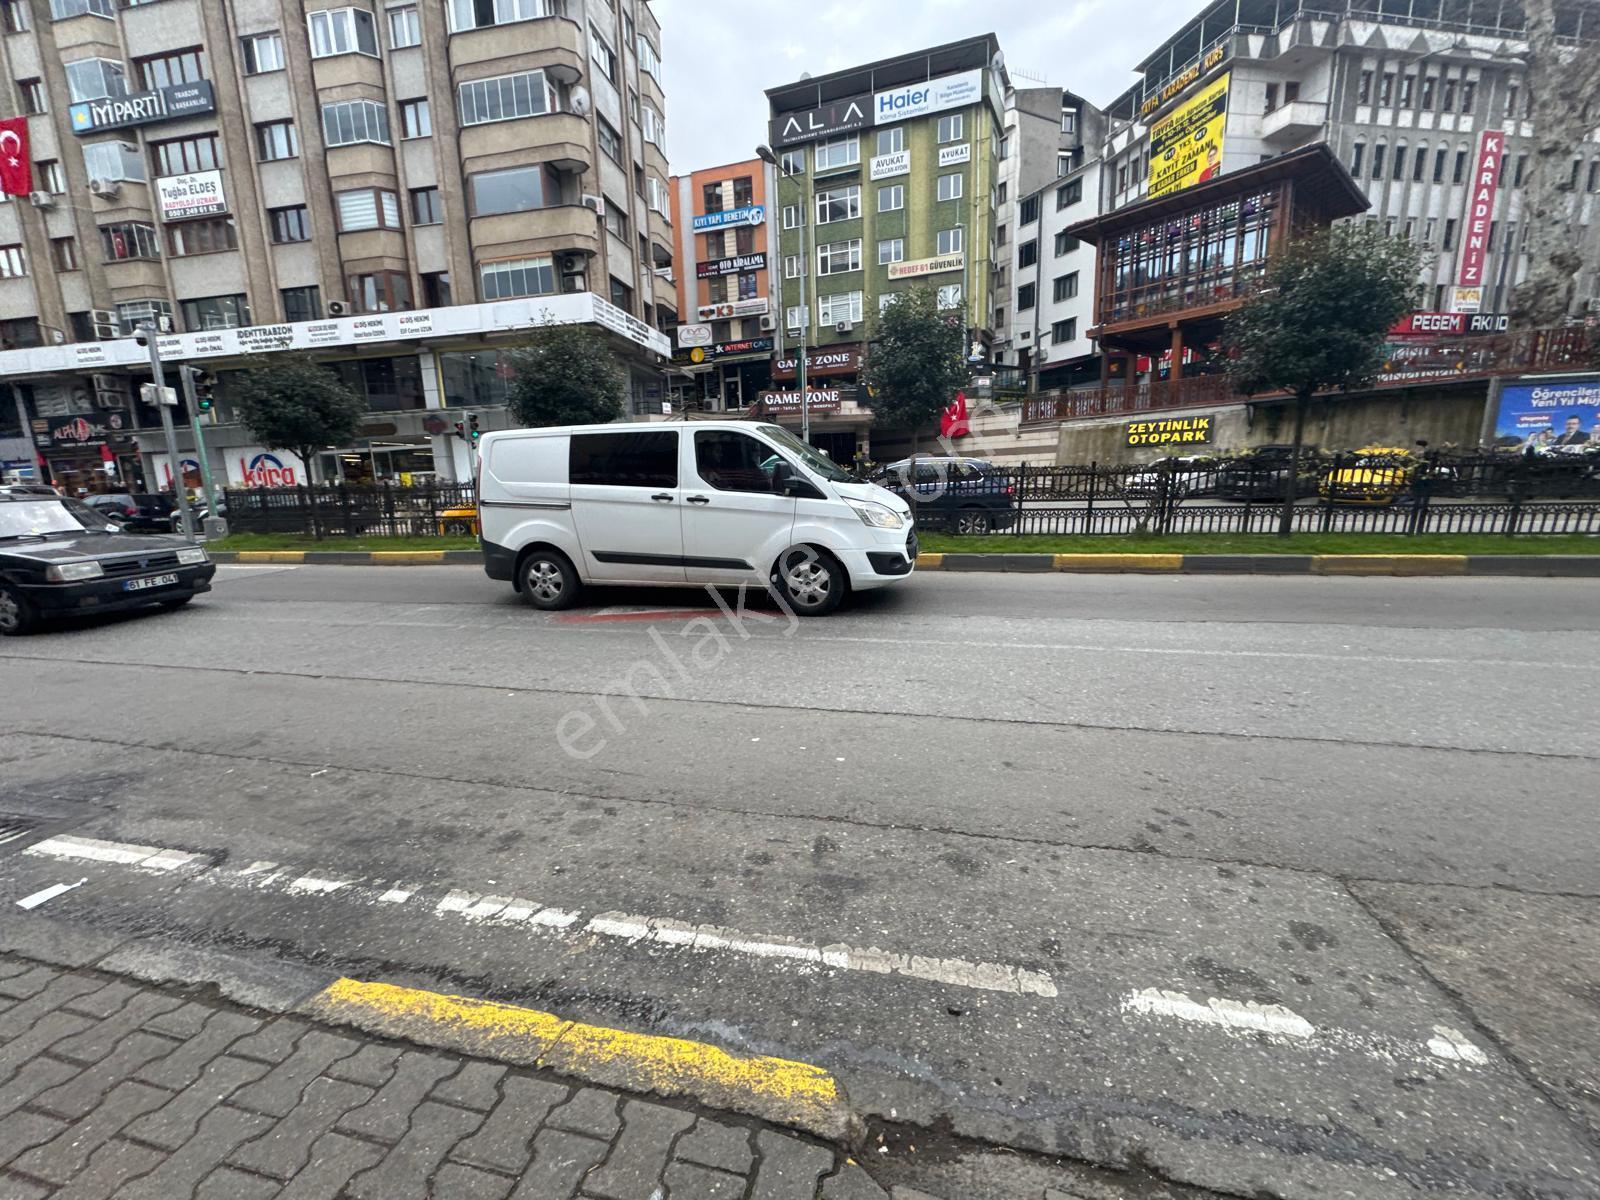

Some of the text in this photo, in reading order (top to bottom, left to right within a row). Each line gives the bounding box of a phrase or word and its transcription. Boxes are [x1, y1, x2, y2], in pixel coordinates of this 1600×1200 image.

[174, 88, 200, 98] TRABZON
[880, 88, 930, 112] Haier
[898, 106, 929, 116] Sistemleri
[941, 146, 968, 159] AVUKAT
[876, 154, 904, 168] AVUKAT
[1156, 160, 1178, 180] KAYIT
[162, 182, 216, 200] Tuğba ELDEŞ
[164, 196, 218, 208] RADYOLOJİ UZMANI
[694, 218, 707, 227] KIYI
[708, 216, 722, 224] YAPI
[724, 210, 750, 222] DENETİM
[720, 260, 732, 270] OTO
[732, 255, 764, 268] KİRALAMA
[900, 257, 963, 274] HEDEF 61 GÜVENLİK
[716, 304, 734, 318] K3
[1412, 315, 1460, 330] PEGEM
[777, 354, 850, 368] GAE ZONE
[764, 391, 839, 404] GAME ZONE
[1532, 398, 1556, 408] Yeni
[1128, 417, 1210, 434] ZEYTİNLİK
[1128, 430, 1206, 444] OTOPARK
[130, 580, 140, 590] 61
[144, 577, 157, 587] FE
